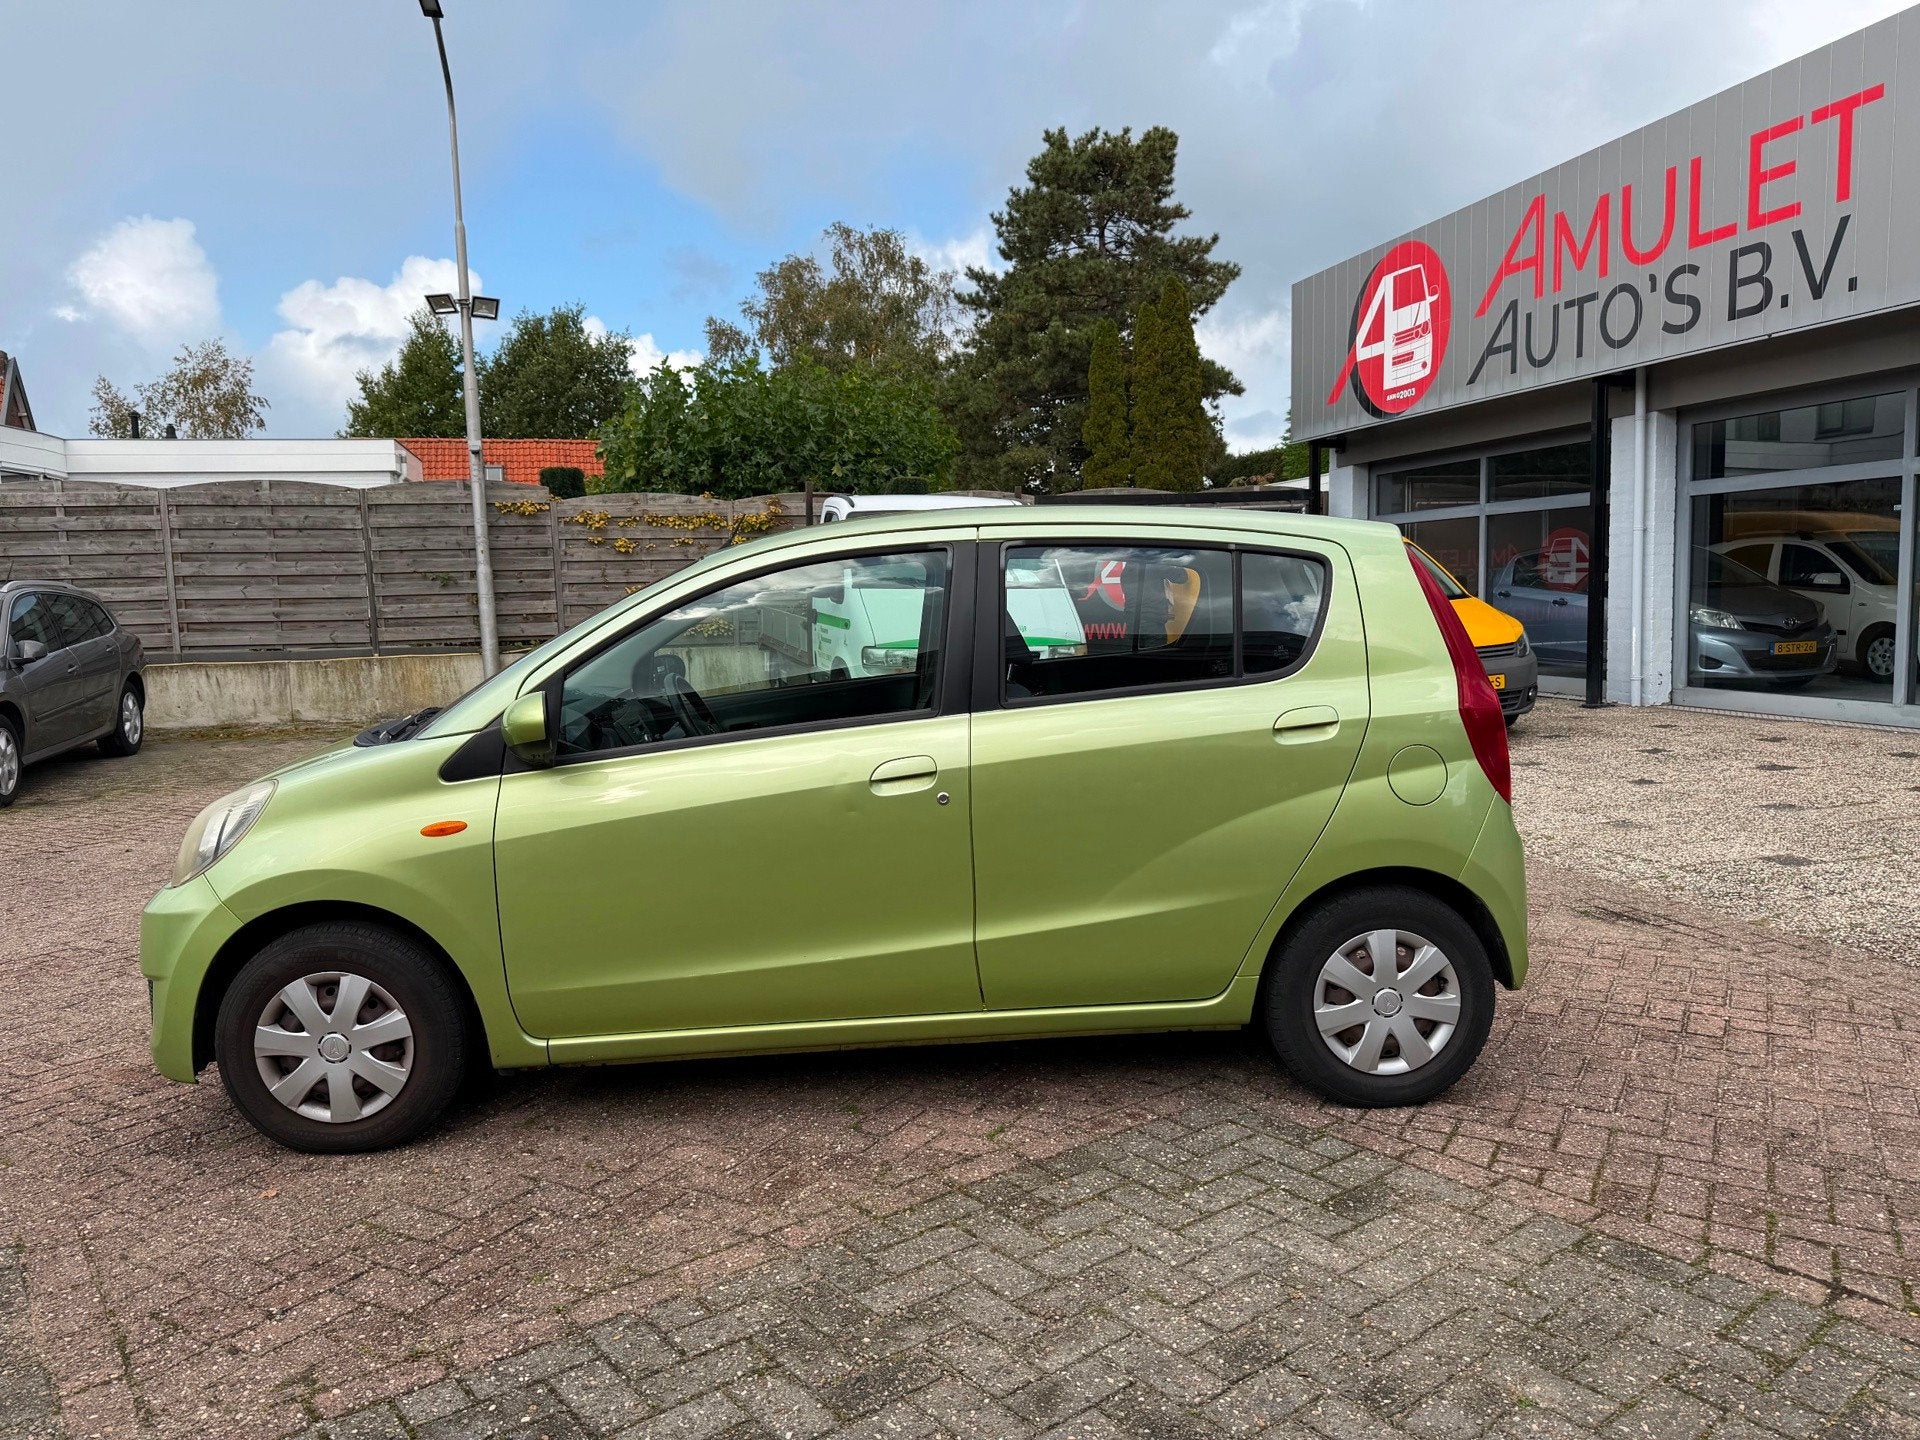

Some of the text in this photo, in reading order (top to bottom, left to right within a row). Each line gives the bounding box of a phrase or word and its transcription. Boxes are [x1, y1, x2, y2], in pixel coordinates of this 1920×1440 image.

[1474, 83, 1885, 318] AMULET
[1466, 214, 1858, 386] AUTO'S B.V.
[1399, 388, 1415, 399] 2003
[1777, 643, 1814, 653] 8-STR-26
